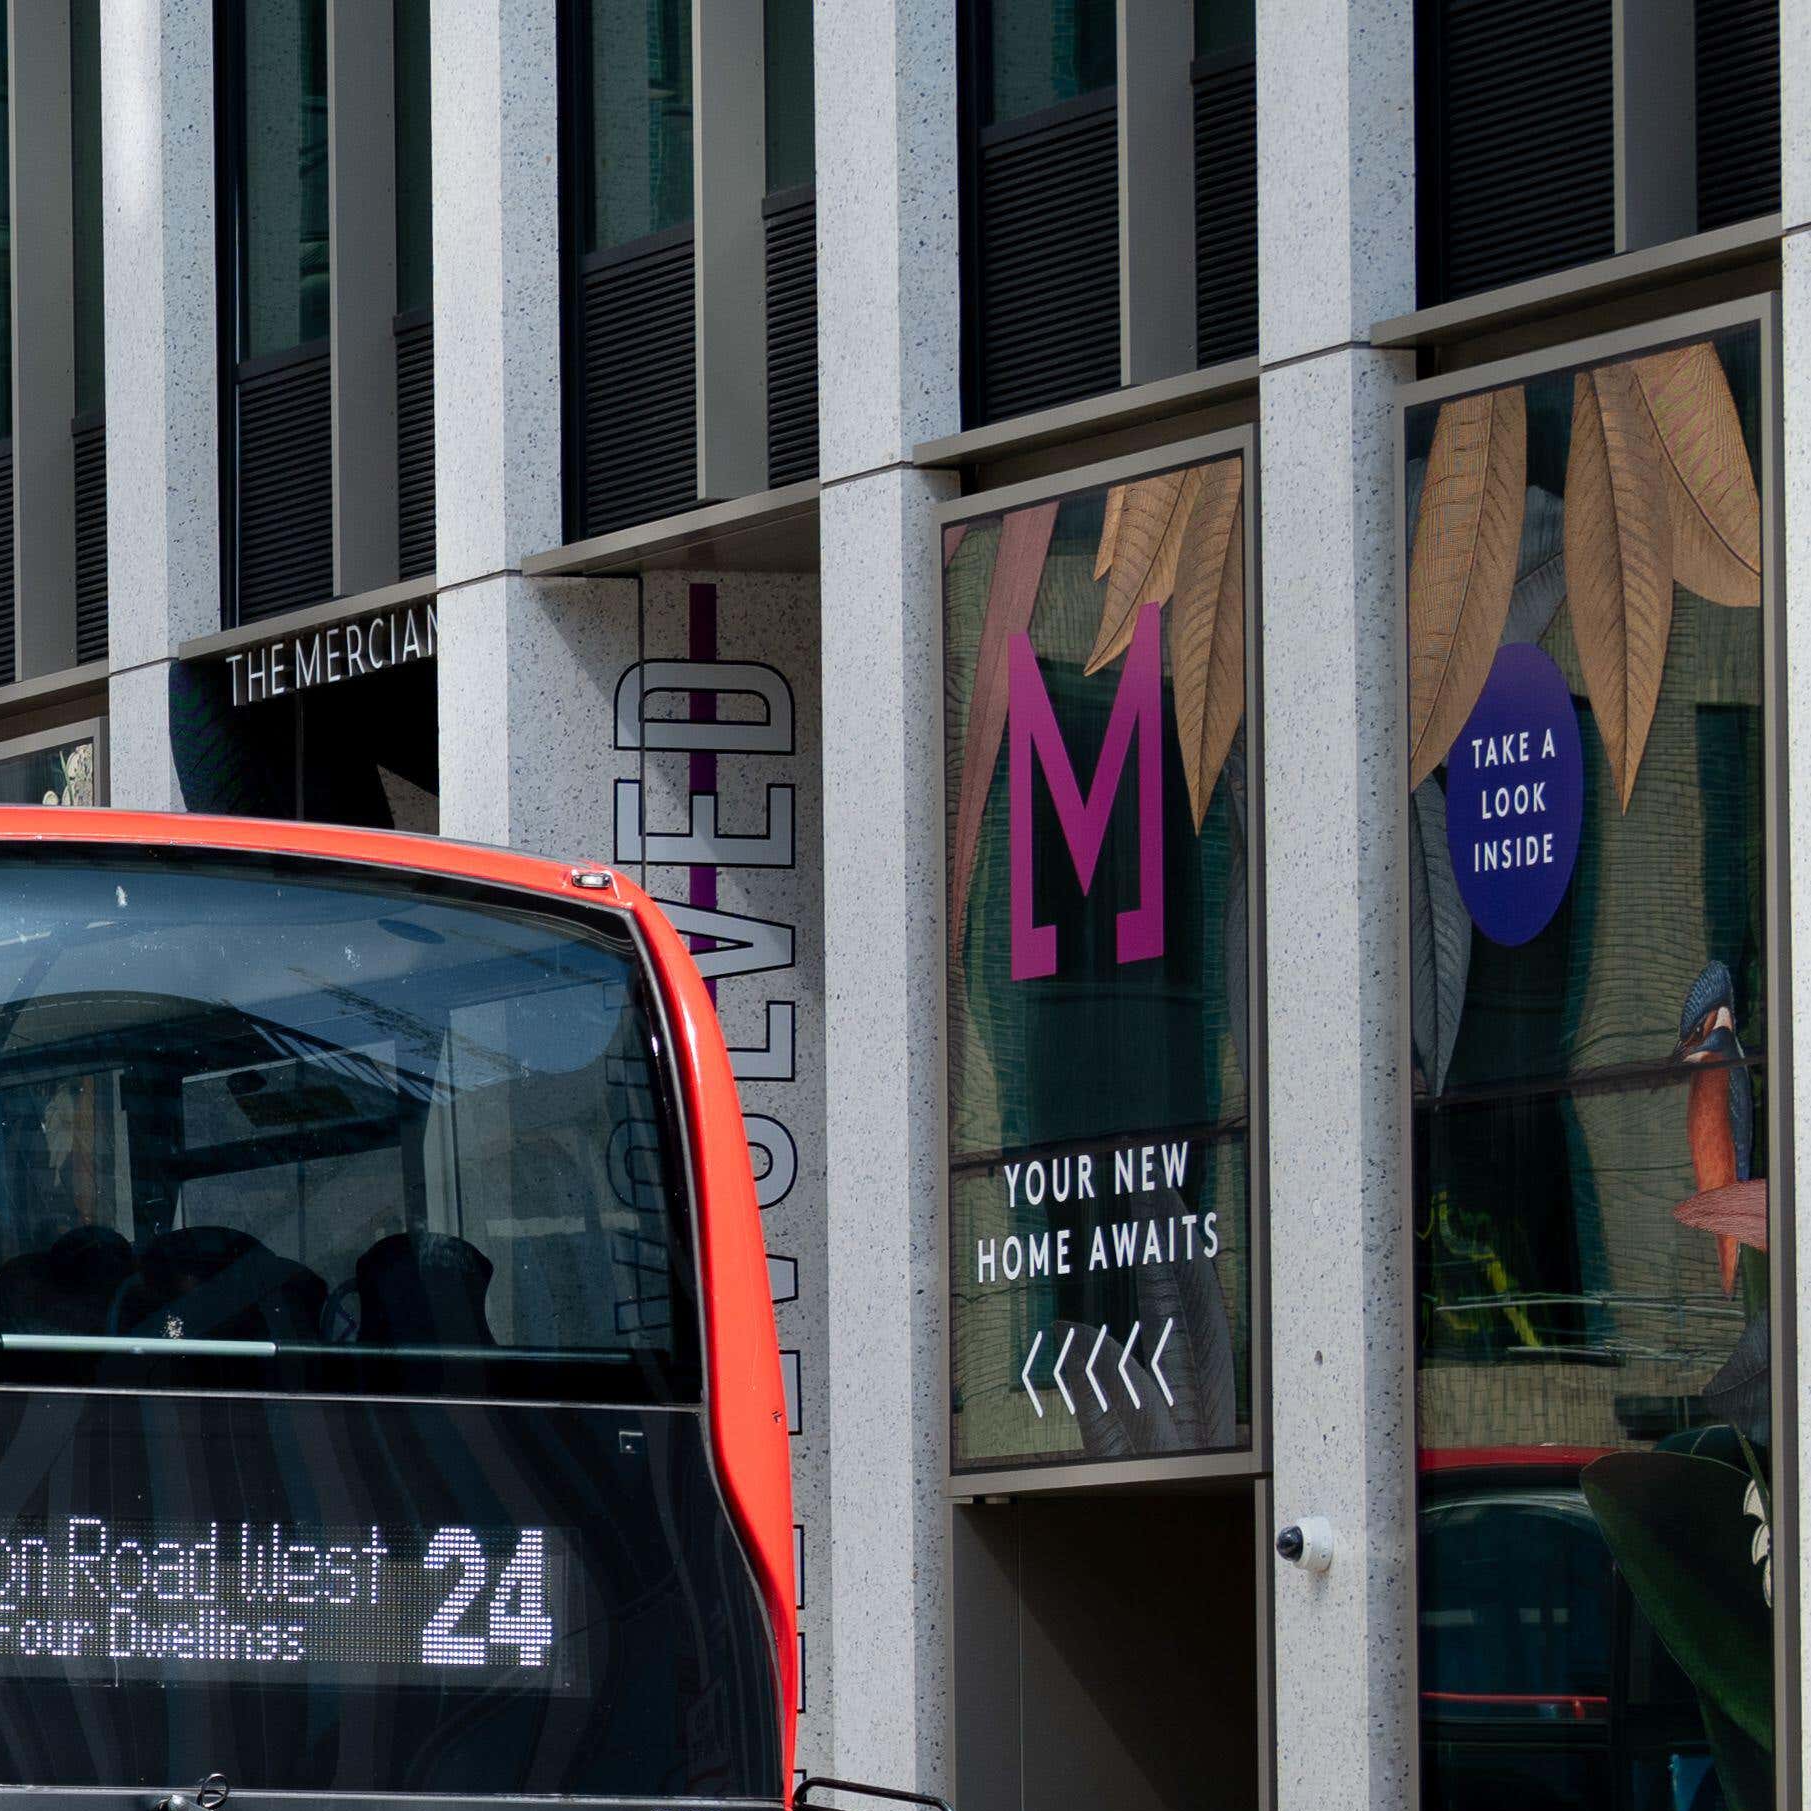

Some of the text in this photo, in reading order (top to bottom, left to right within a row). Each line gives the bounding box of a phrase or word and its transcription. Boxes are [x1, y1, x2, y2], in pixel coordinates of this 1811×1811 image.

[225, 643, 285, 707] THE
[1472, 728, 1556, 769] TAKE A
[1482, 782, 1546, 820] LOOK
[1474, 834, 1553, 872] INSIDE
[1004, 1142, 1190, 1209] YOUR NEW
[977, 1213, 1220, 1284] HOME AWAITS
[68, 1518, 217, 1601] Road
[240, 1523, 388, 1604] West
[422, 1527, 553, 1667] 24
[109, 1606, 305, 1661] Dwellings
